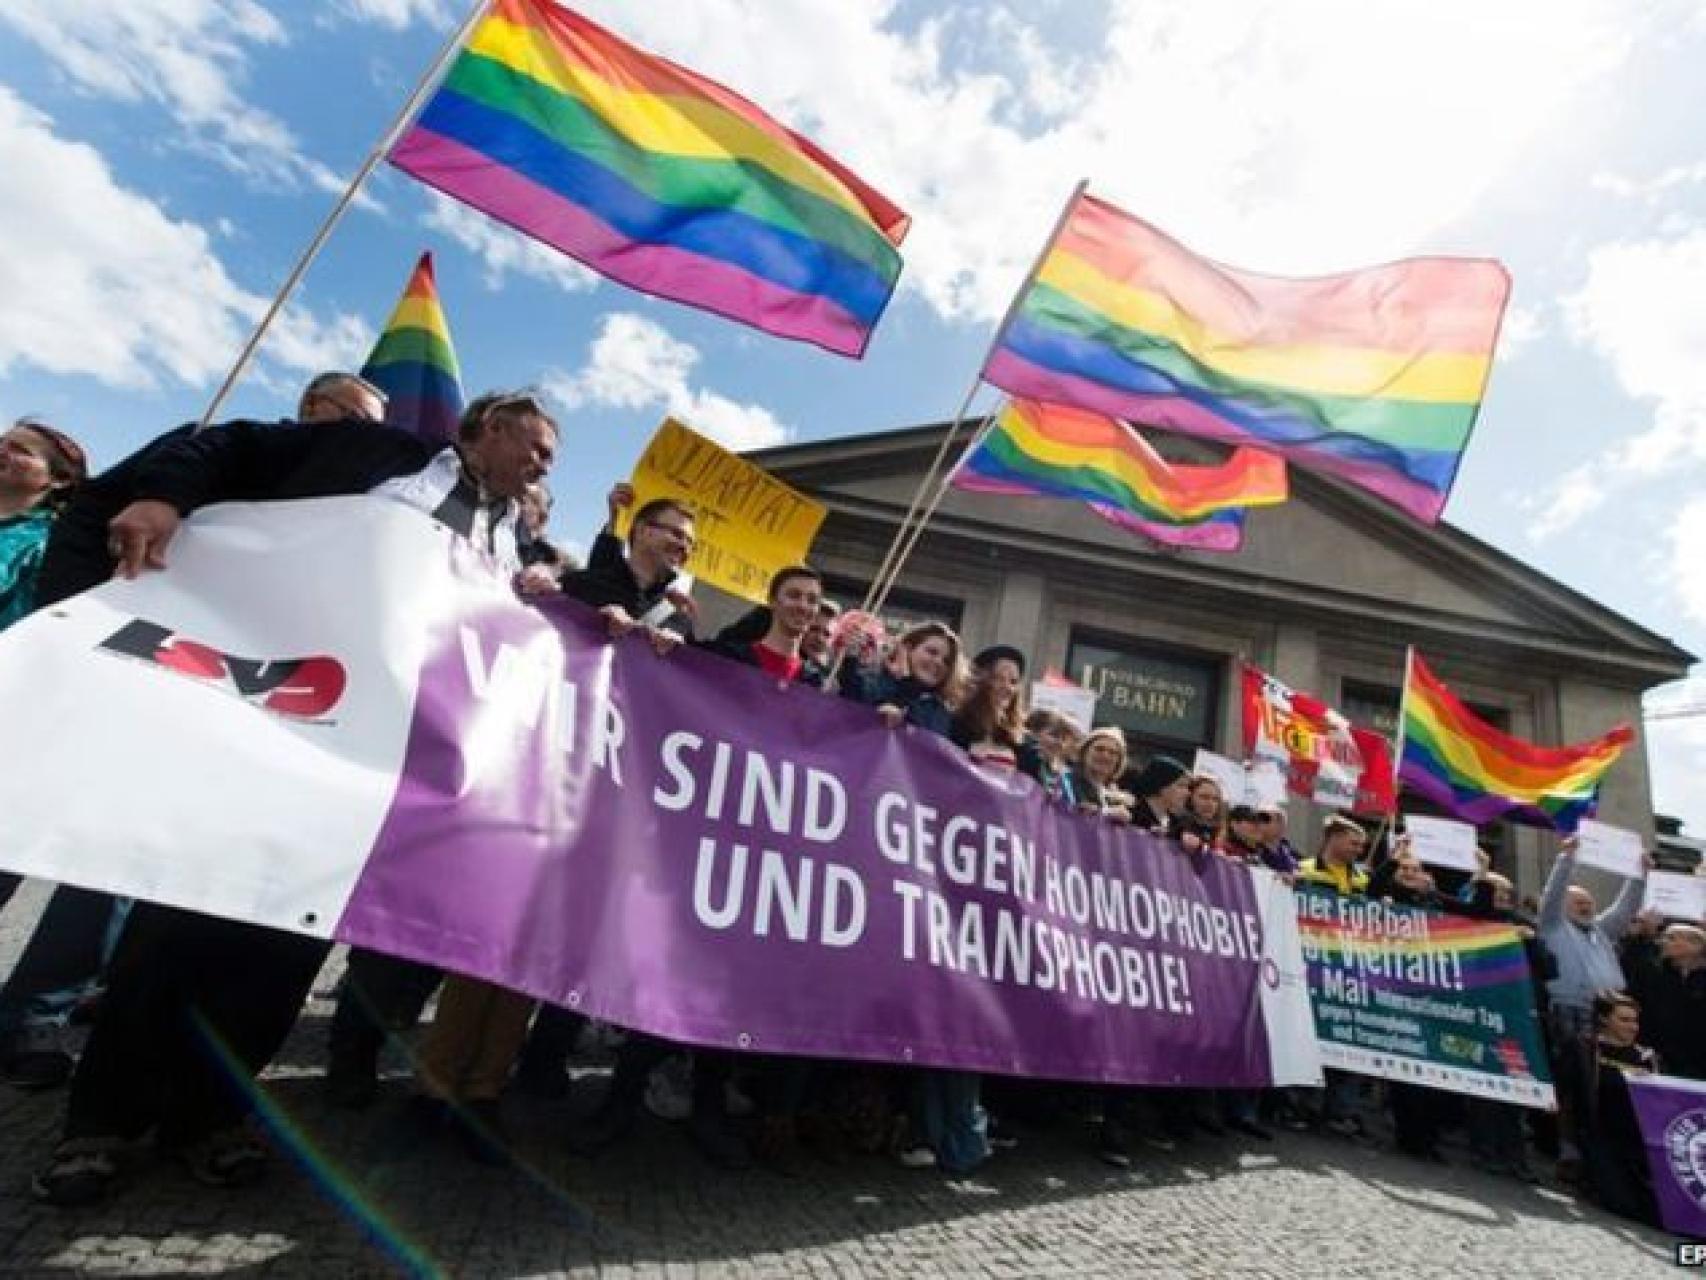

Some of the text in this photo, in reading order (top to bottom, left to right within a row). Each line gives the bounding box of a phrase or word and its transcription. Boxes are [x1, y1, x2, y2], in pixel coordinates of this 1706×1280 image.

[1112, 686, 1187, 719] BAHN
[653, 731, 848, 843] SIND
[873, 791, 1036, 902] GEGEN
[1045, 853, 1260, 962] HOMOPHOBIE
[693, 838, 1195, 1015] UND TRANSPHOBIE!
[1338, 896, 1428, 939] Fußball
[1323, 965, 1369, 1007] Mai
[1339, 931, 1464, 991] Vielfalt!
